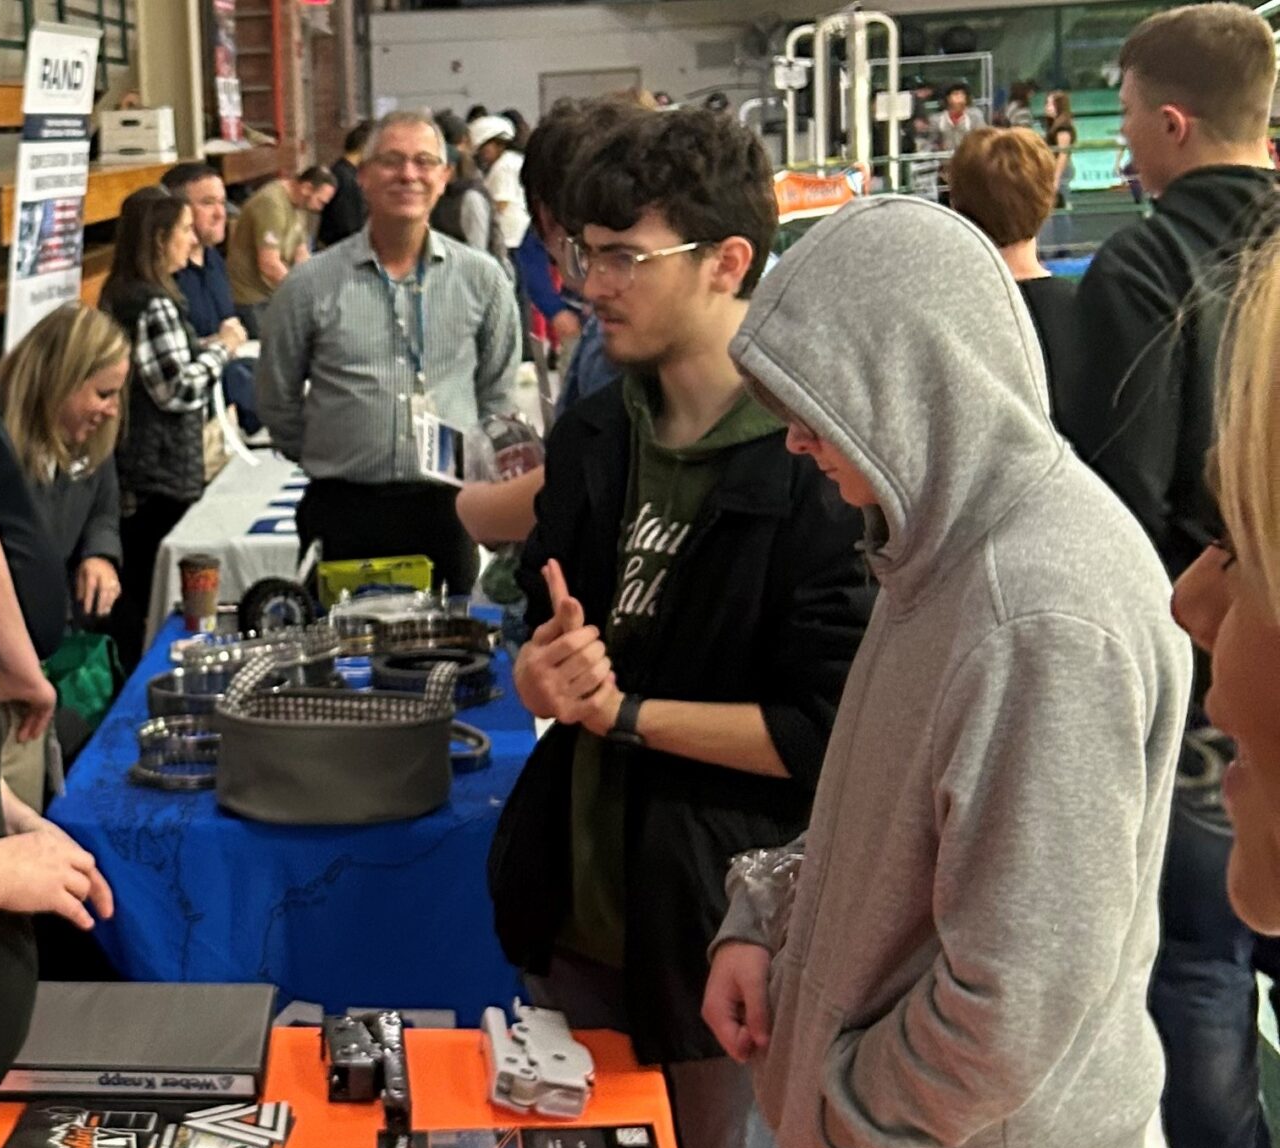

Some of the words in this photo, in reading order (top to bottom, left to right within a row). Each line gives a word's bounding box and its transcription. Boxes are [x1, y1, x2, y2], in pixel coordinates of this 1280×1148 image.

[40, 57, 84, 91] RAND
[98, 1072, 155, 1090] Knapp
[160, 1076, 217, 1091] Weber
